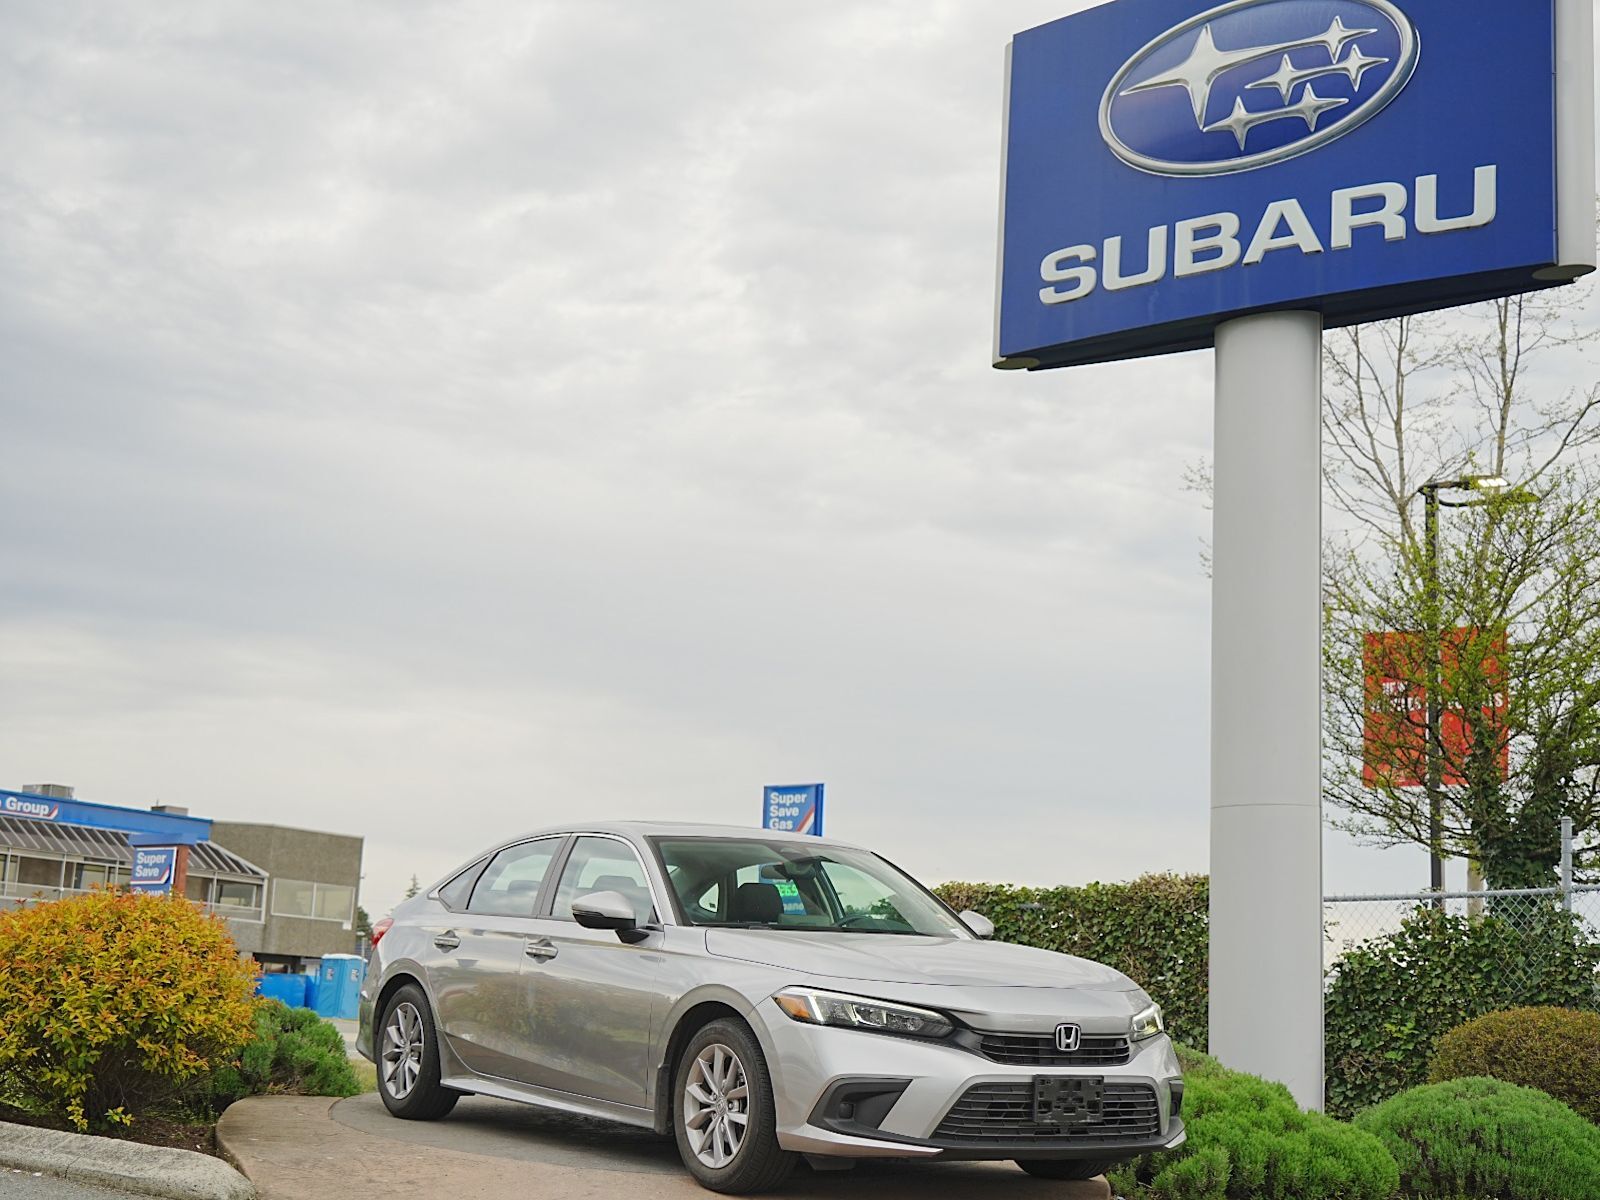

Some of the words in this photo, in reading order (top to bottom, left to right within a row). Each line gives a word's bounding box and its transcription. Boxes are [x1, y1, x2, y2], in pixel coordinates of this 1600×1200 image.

[1038, 164, 1497, 305] SUBARU
[770, 792, 807, 806] Super
[6, 796, 50, 817] Group
[769, 805, 800, 817] Save
[769, 818, 793, 830] Gas
[137, 851, 167, 866] Super
[135, 865, 160, 877] Save
